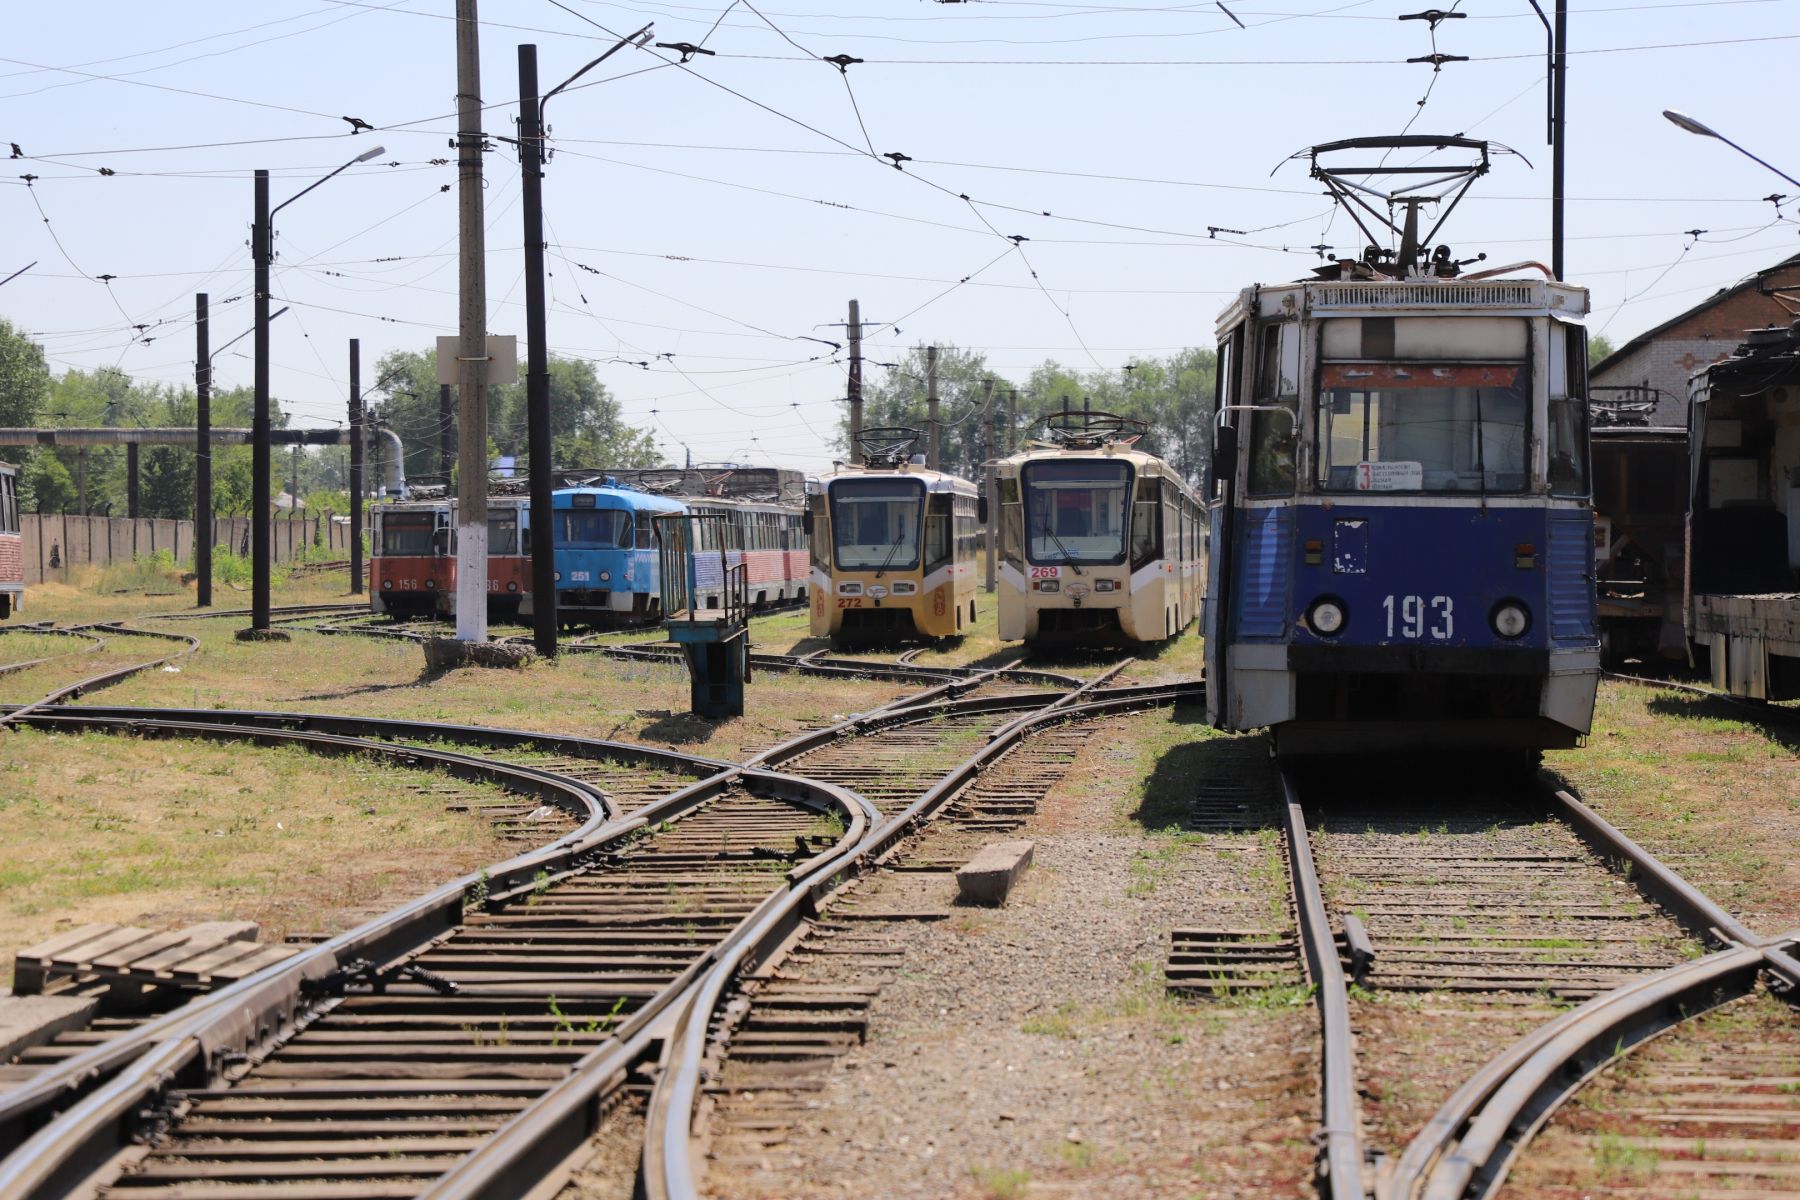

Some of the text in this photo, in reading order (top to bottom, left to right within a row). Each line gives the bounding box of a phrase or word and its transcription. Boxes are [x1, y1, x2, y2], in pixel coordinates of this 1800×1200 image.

[1359, 464, 1371, 490] 3
[571, 572, 590, 581] 251
[1032, 567, 1058, 578] 269
[399, 580, 417, 590] 156
[838, 598, 862, 608] 272
[1382, 595, 1453, 639] 193
